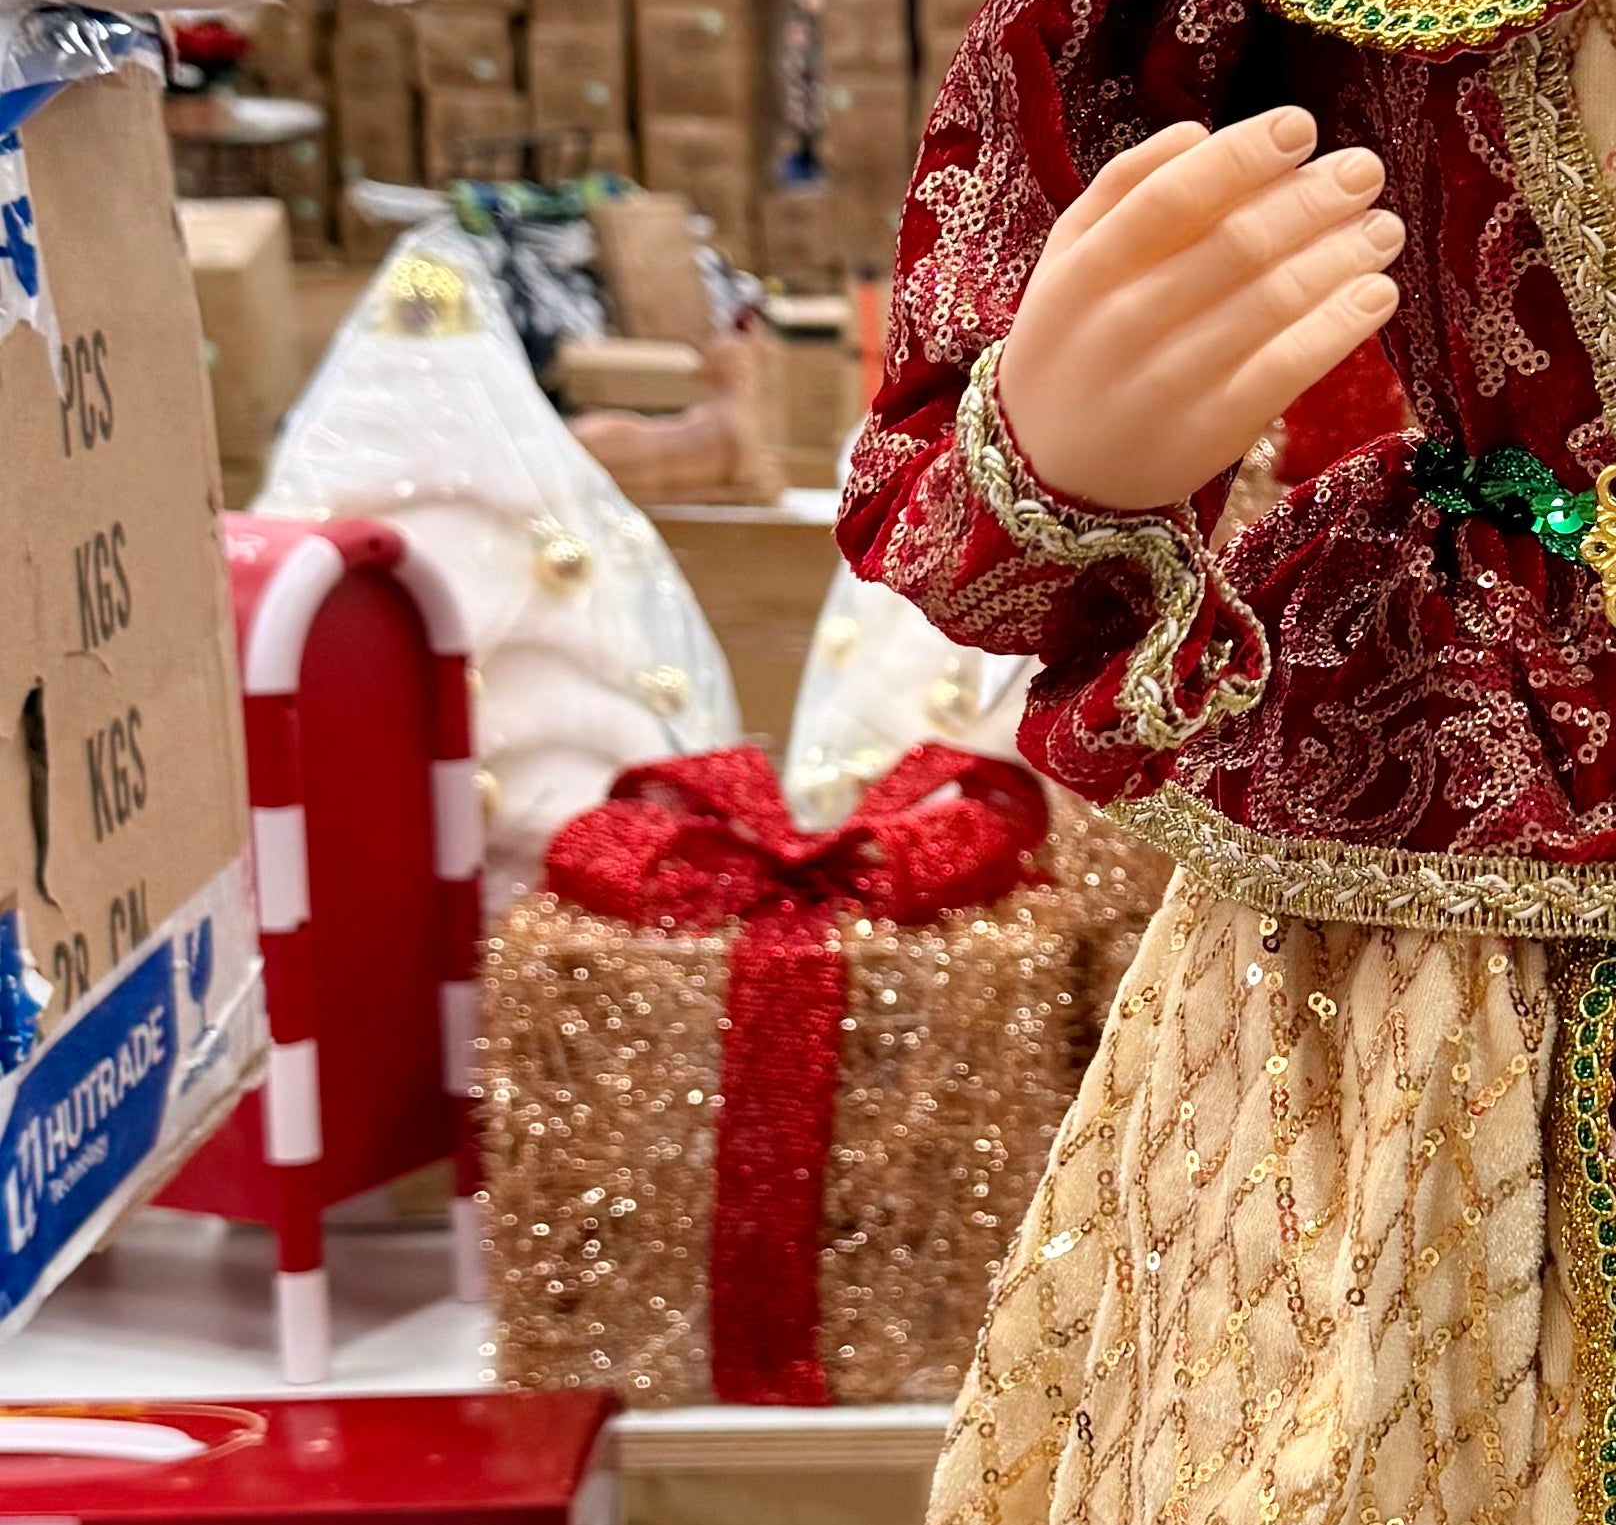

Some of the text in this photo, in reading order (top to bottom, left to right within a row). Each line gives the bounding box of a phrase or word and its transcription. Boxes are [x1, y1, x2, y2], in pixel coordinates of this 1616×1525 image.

[60, 329, 114, 458] PCS
[73, 520, 132, 652] KGS
[85, 703, 148, 844] KGS
[46, 1005, 166, 1172] HUTRADE
